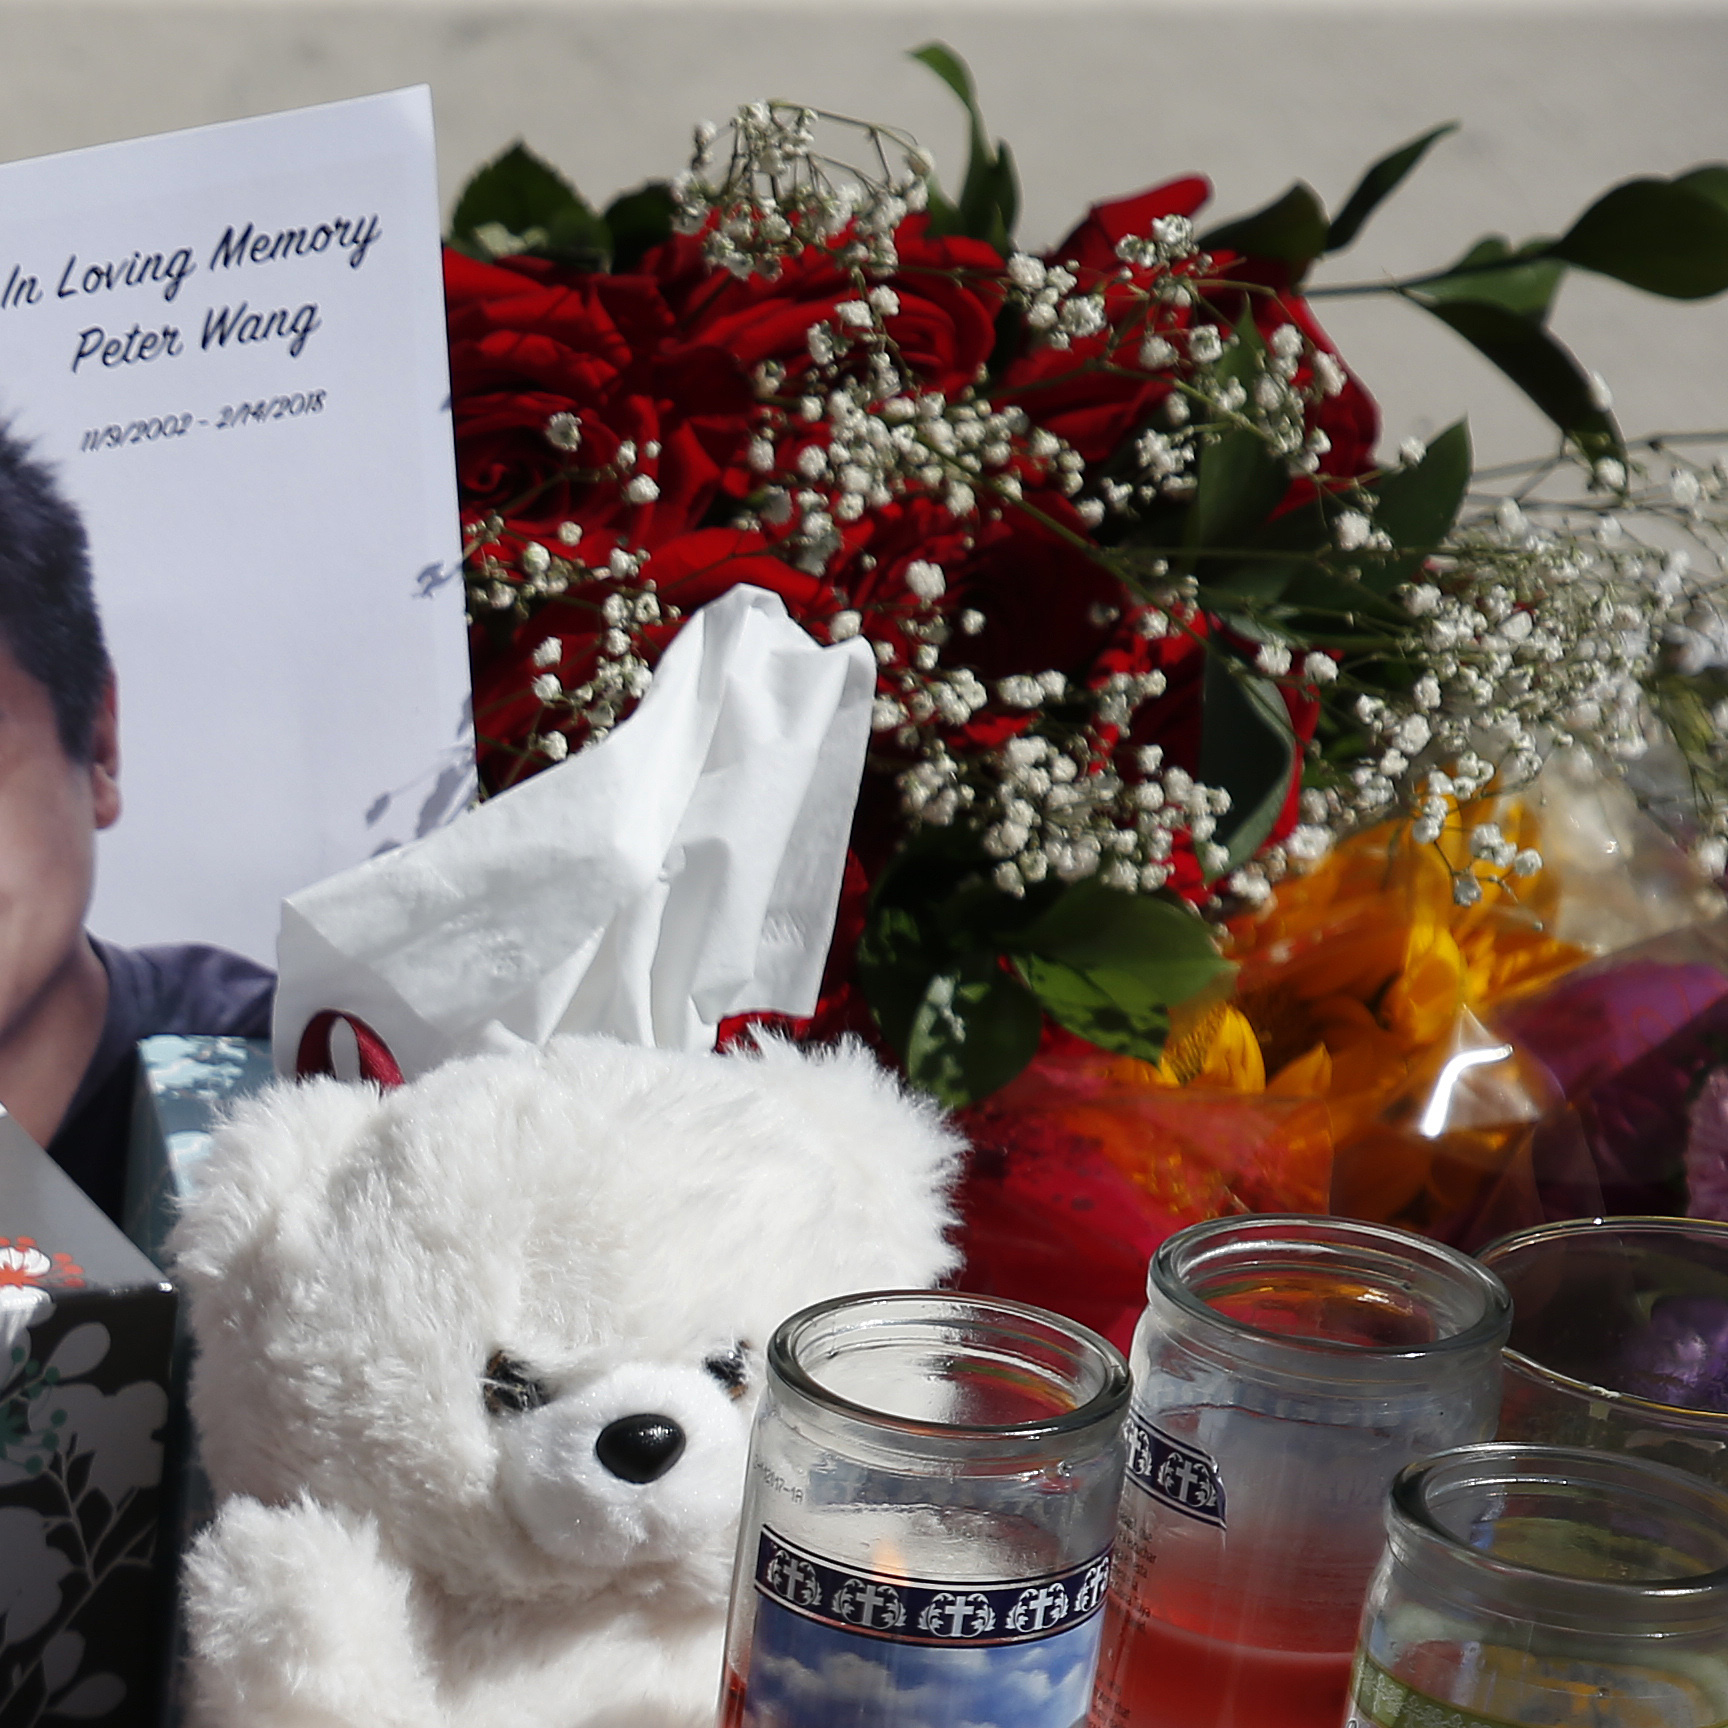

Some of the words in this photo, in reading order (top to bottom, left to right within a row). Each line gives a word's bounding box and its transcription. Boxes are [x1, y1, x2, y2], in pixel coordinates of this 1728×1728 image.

[0, 263, 44, 309] In
[56, 247, 198, 302] Loving
[209, 213, 382, 270] Memory
[72, 322, 183, 374] Peter
[201, 301, 323, 358] Wang
